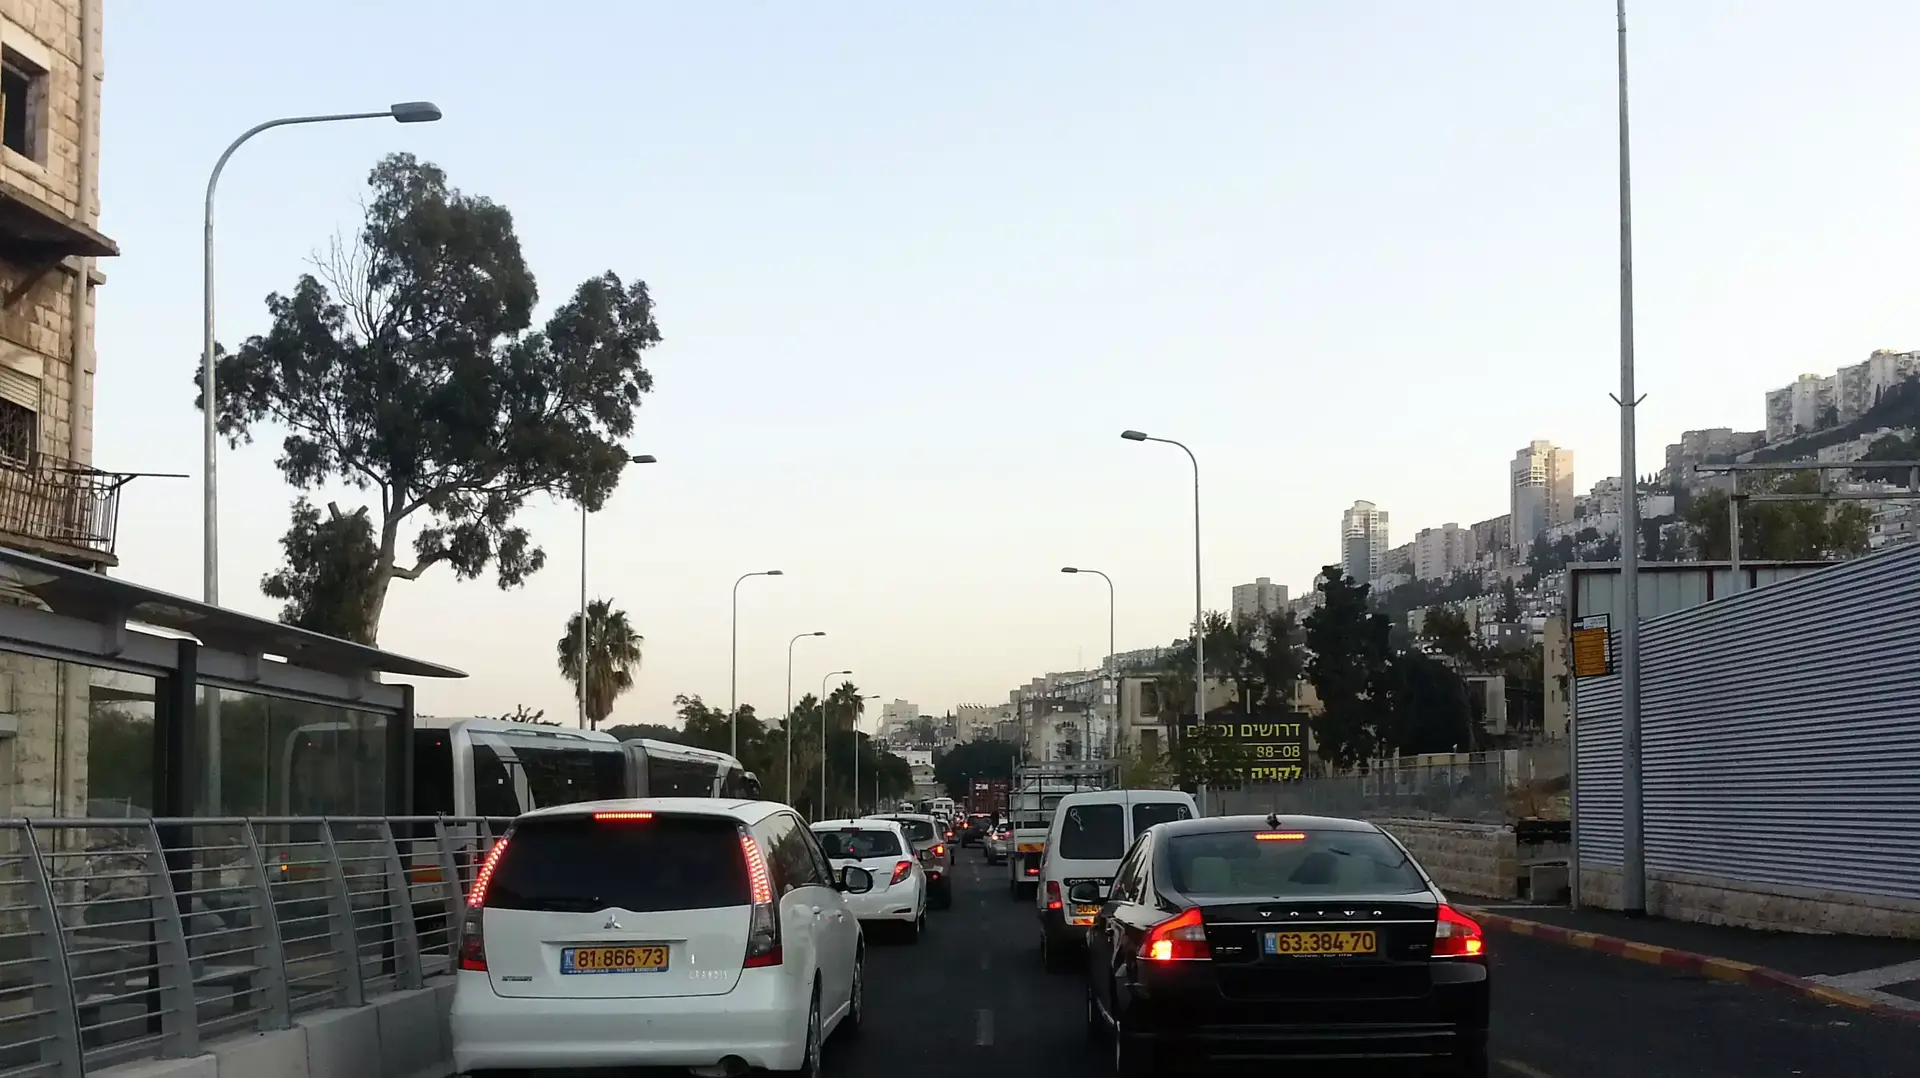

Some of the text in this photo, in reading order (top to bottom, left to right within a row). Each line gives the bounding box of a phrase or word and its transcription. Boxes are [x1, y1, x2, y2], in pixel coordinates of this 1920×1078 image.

[1186, 723, 1301, 738] דרושים נכם
[1251, 764, 1302, 781] לקניה
